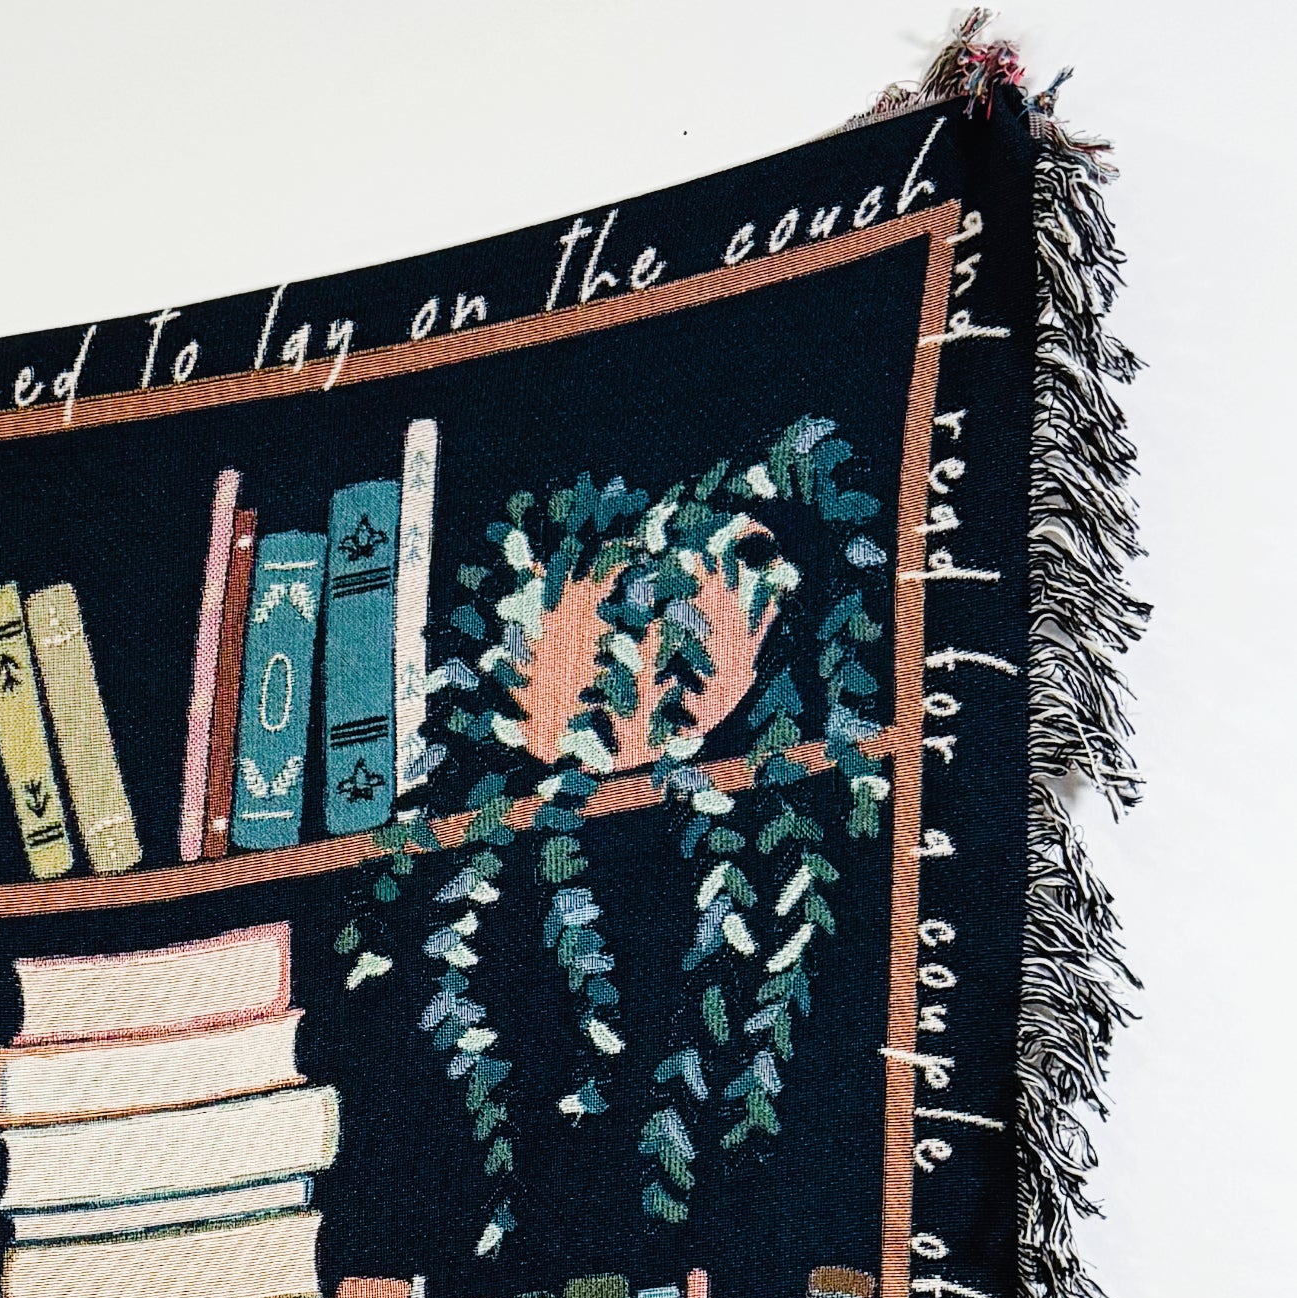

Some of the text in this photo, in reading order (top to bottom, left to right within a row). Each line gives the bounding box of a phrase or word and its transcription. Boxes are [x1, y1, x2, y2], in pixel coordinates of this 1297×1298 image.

[139, 308, 202, 391] to
[253, 282, 358, 392] lay
[409, 292, 490, 342] on
[546, 208, 667, 310] the
[724, 115, 948, 266] couch
[918, 208, 1012, 347] and
[900, 408, 1002, 582] read
[922, 645, 1019, 764] for
[910, 828, 957, 860] a
[879, 918, 1006, 1173] couple
